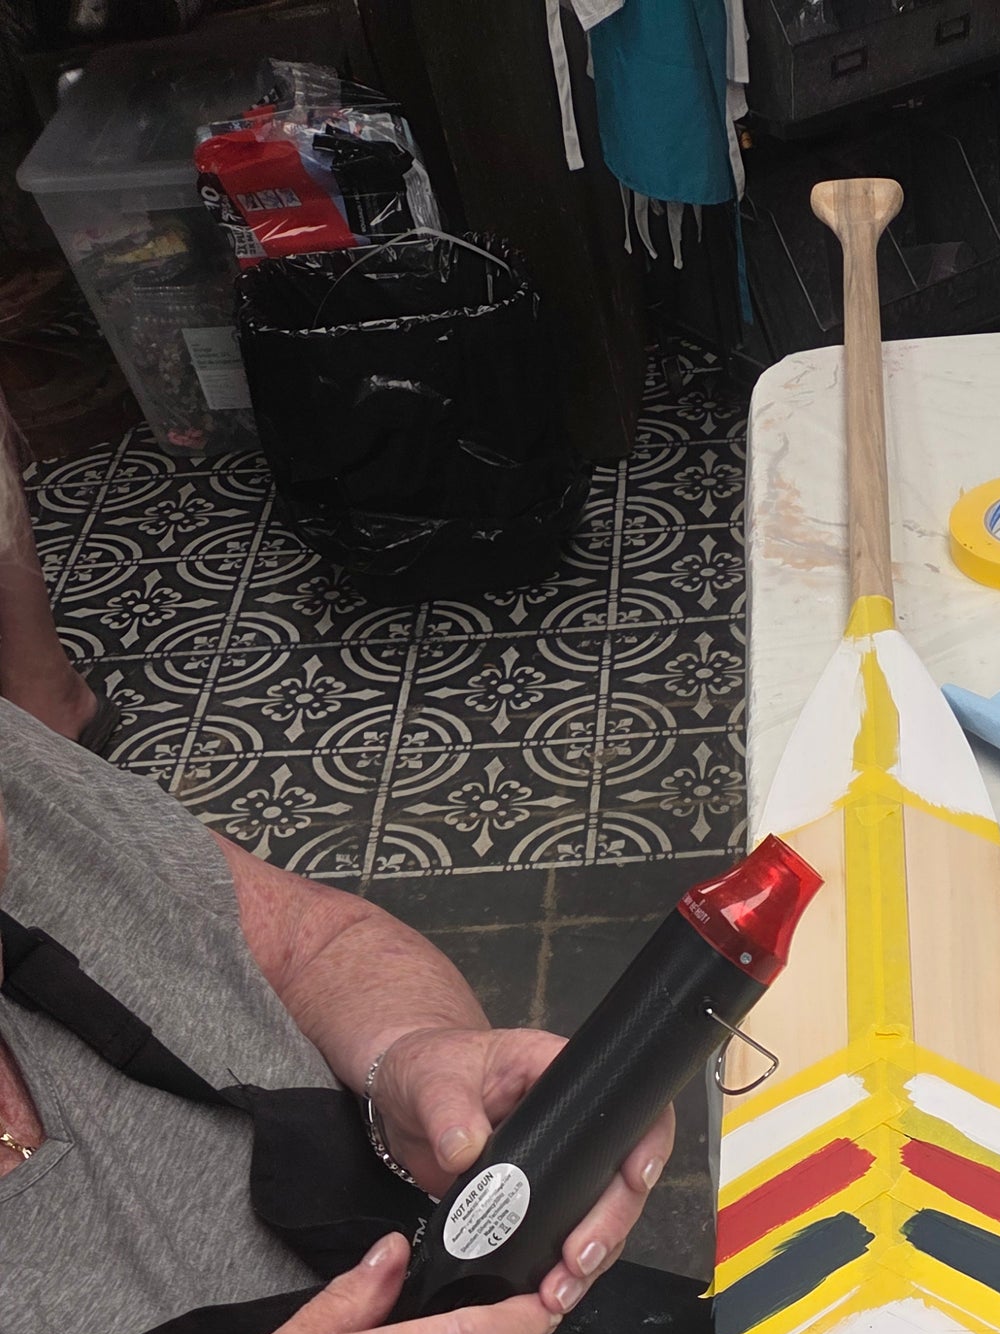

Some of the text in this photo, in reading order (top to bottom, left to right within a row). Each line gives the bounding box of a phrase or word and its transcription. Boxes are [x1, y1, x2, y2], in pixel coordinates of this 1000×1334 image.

[450, 1205, 466, 1223] HOT
[465, 1190, 478, 1208] AIR
[476, 1171, 494, 1192] GUN
